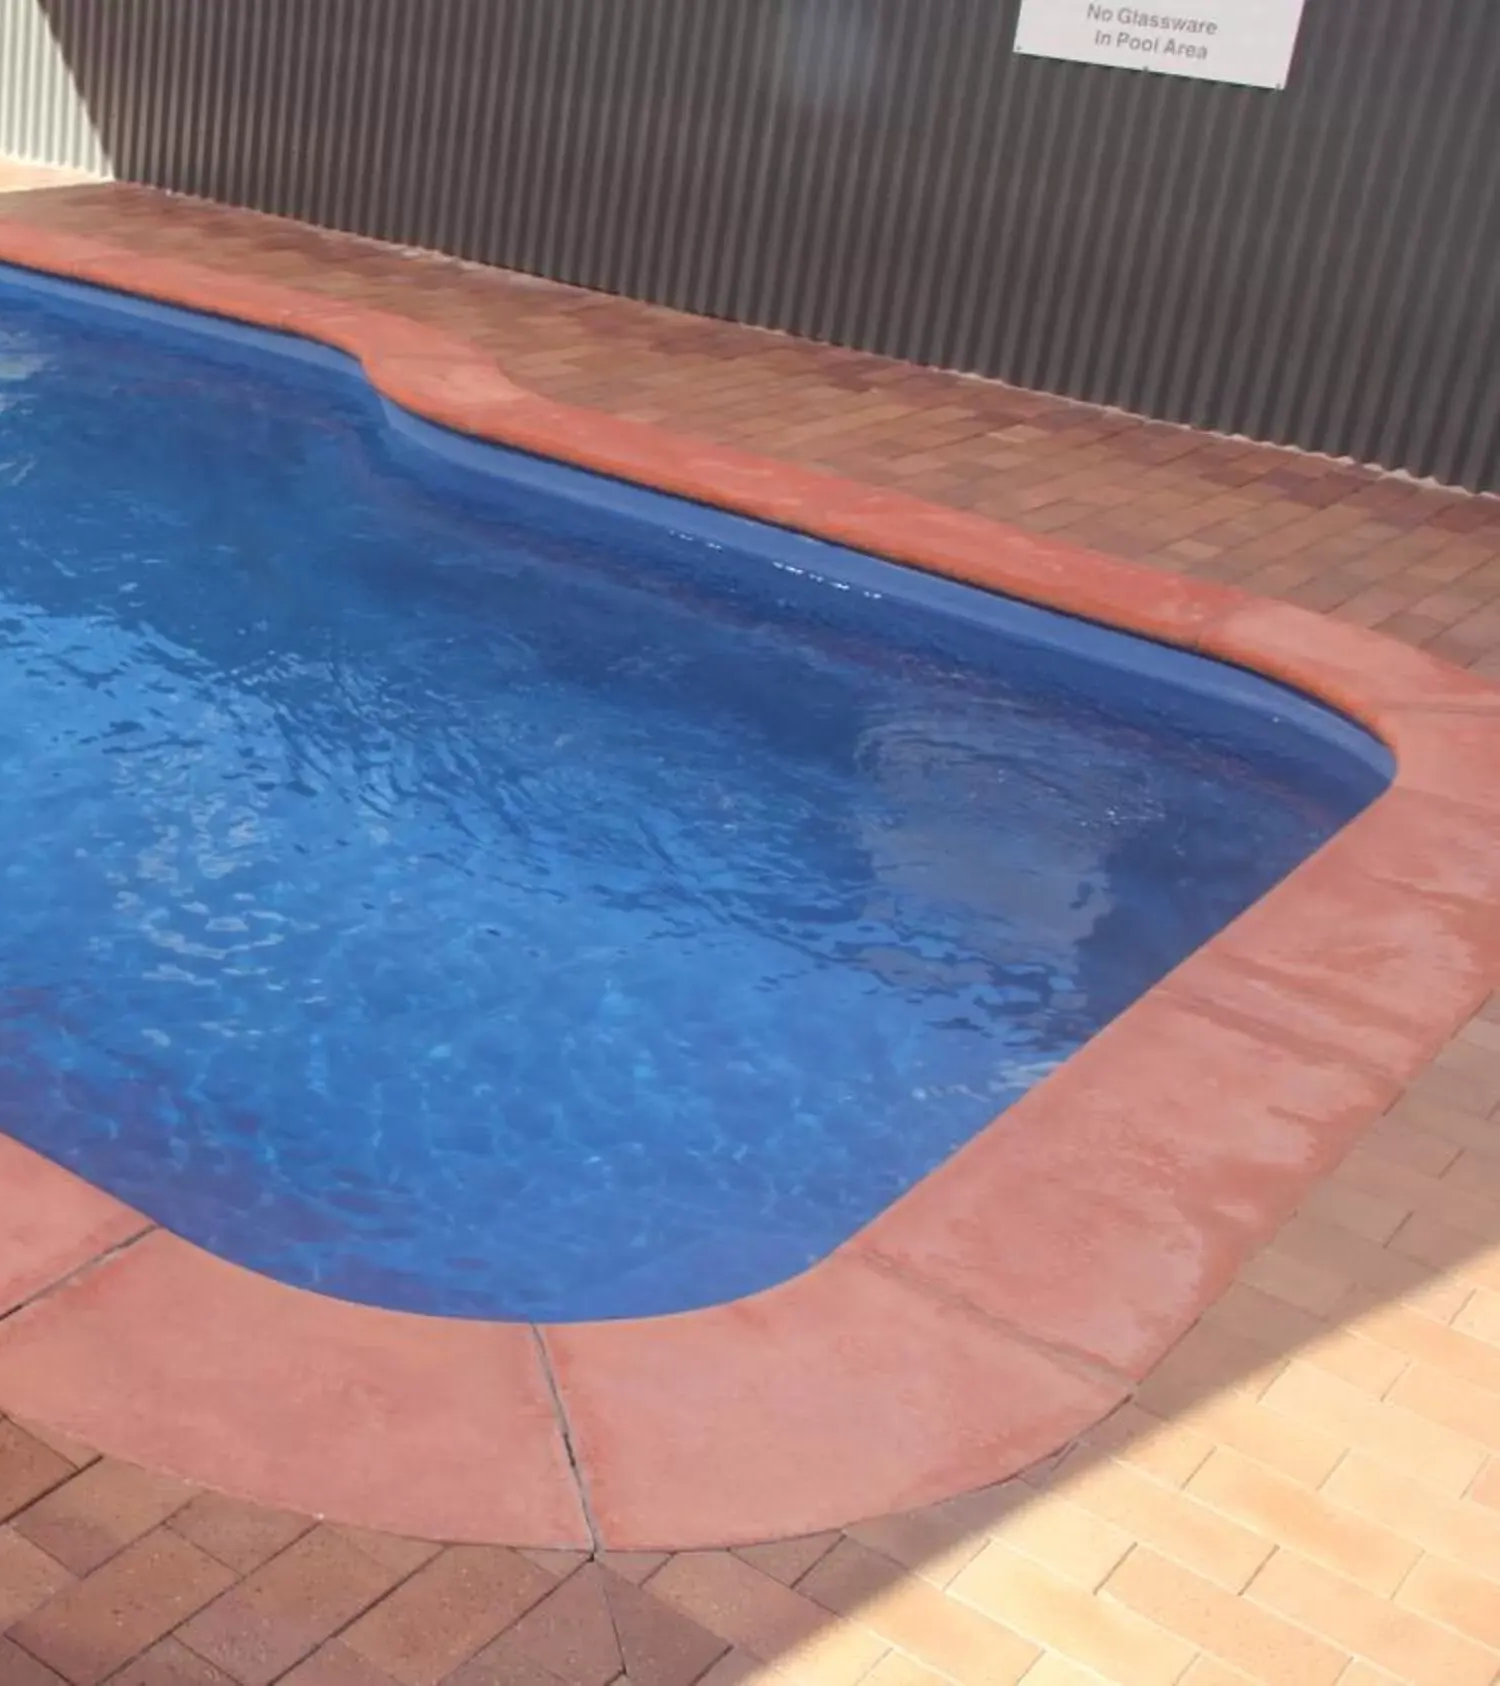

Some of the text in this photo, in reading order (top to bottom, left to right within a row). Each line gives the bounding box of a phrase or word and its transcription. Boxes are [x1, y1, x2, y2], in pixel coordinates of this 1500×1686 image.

[1087, 3, 1219, 35] No Glassware
[1094, 29, 1208, 60] In Pool Area
